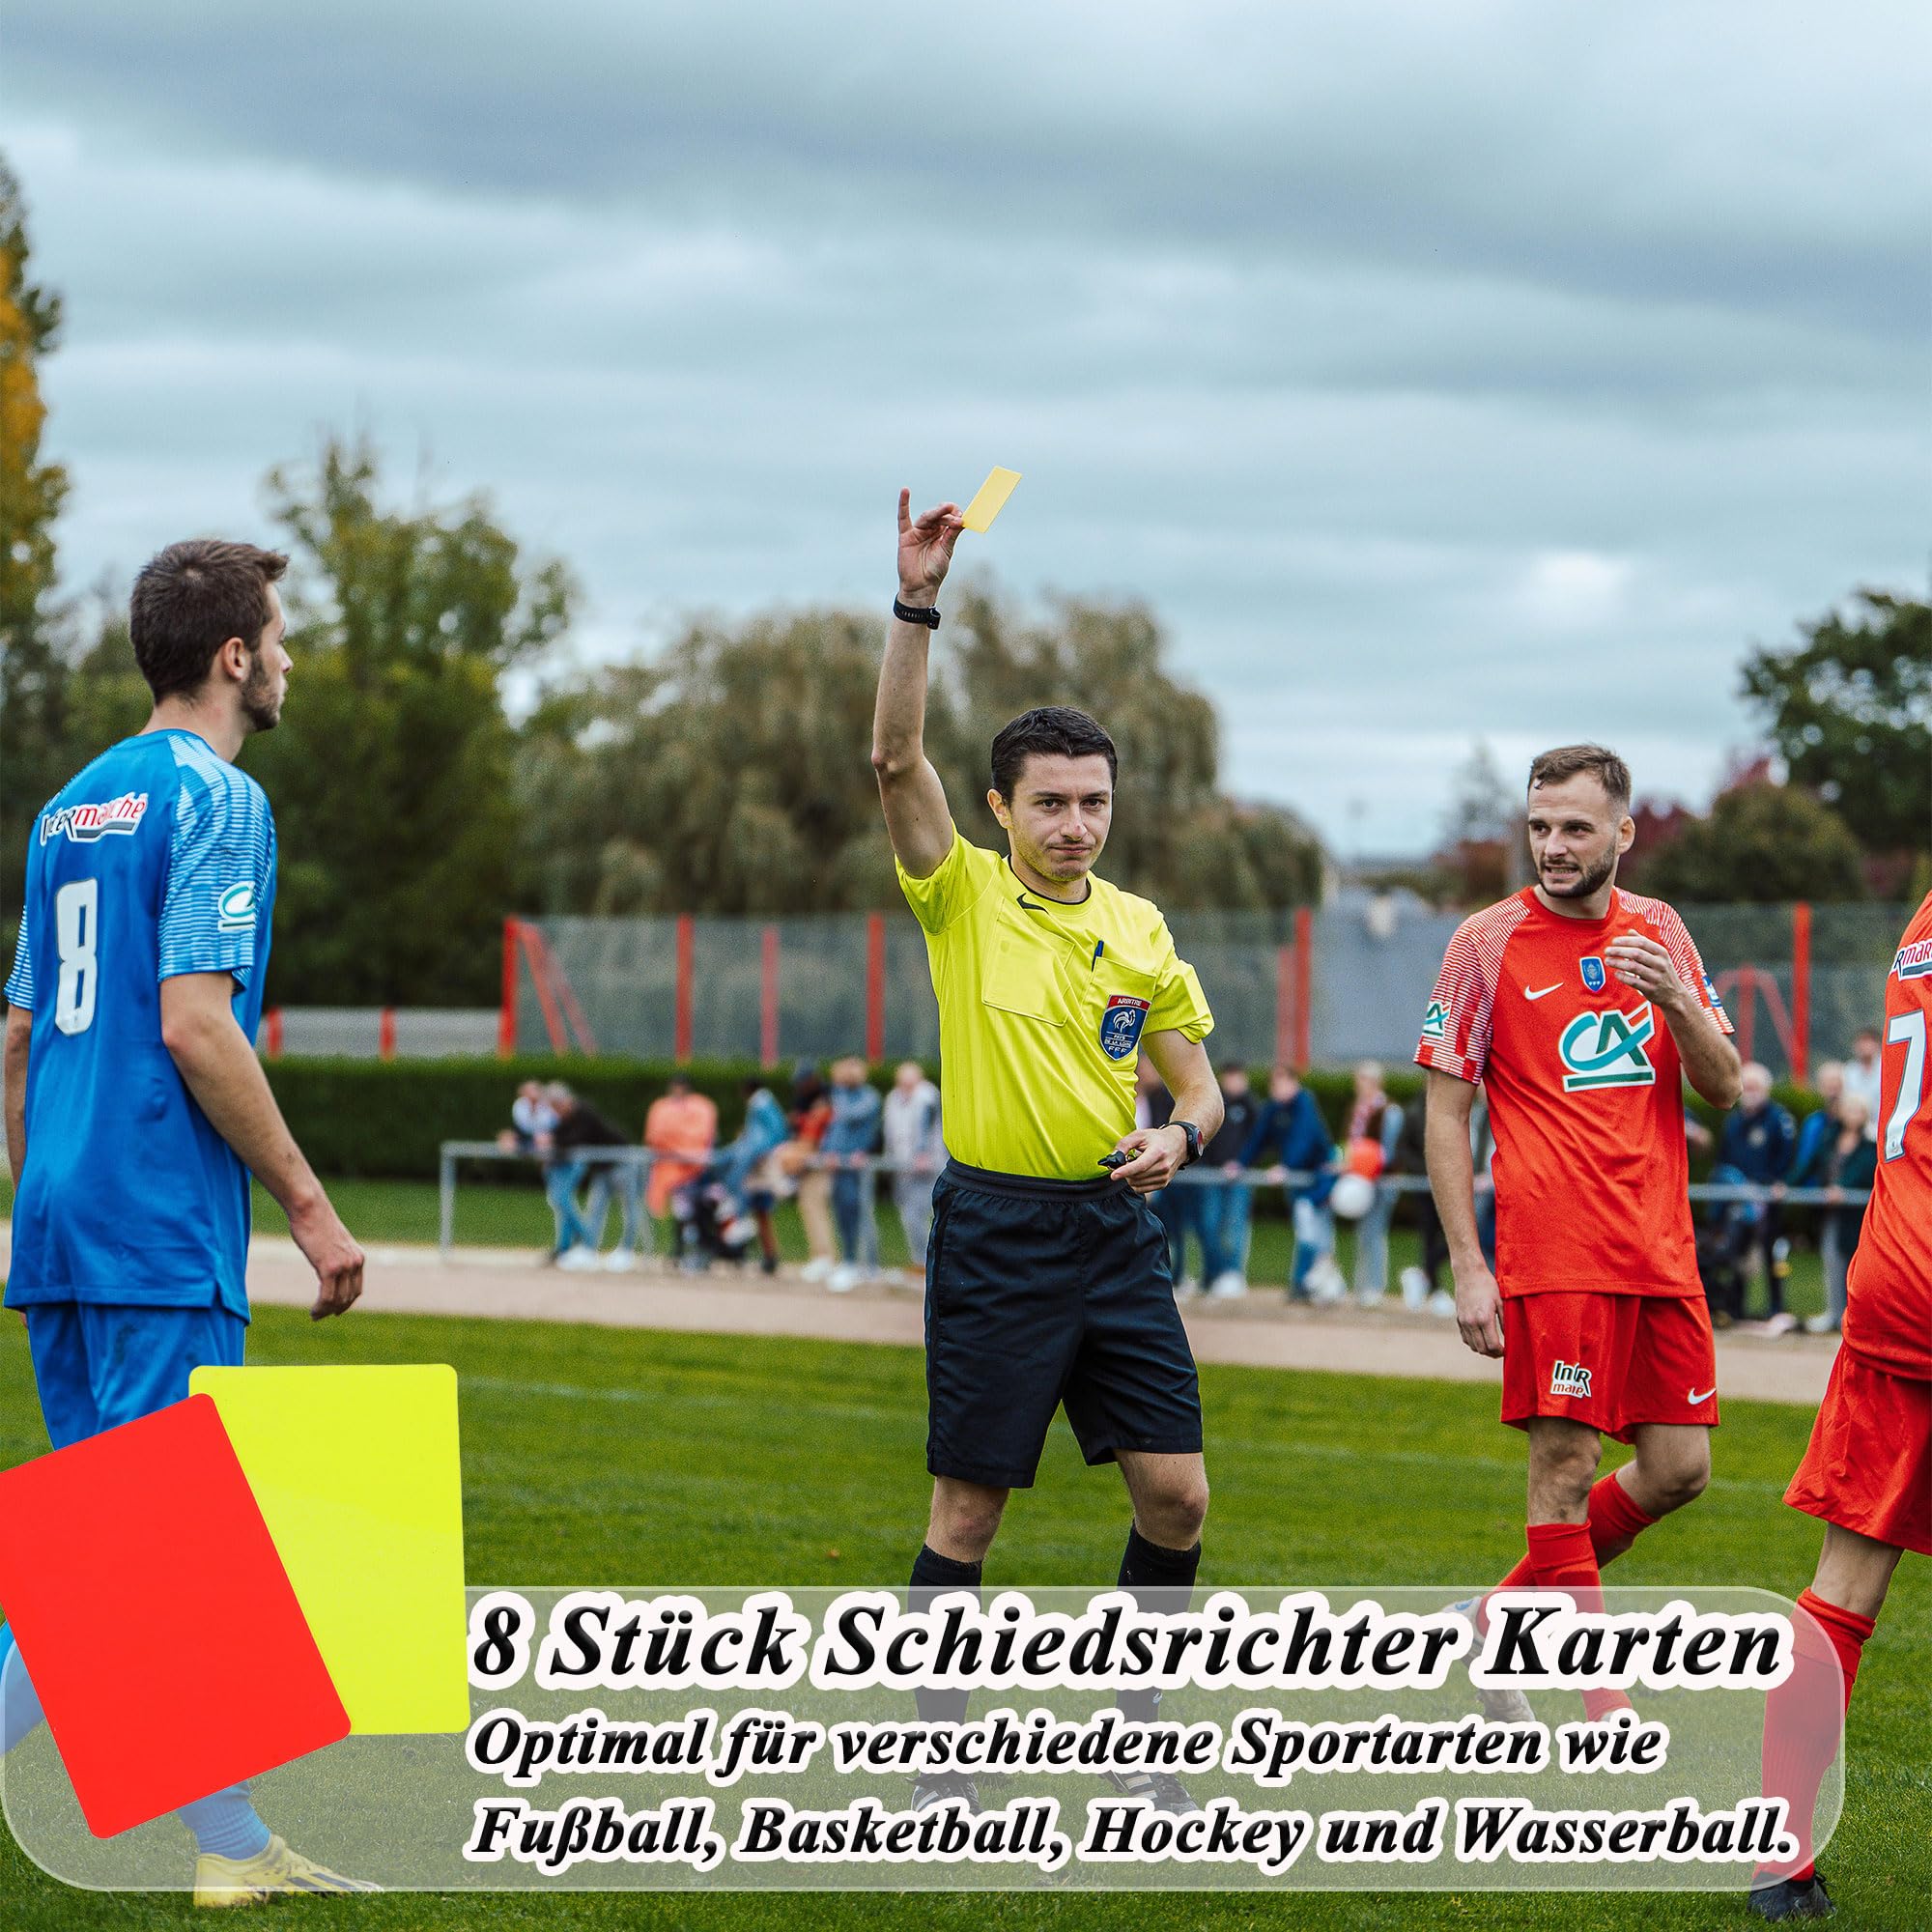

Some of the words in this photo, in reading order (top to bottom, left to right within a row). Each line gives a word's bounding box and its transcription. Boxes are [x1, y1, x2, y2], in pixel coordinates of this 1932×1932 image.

[55, 877, 98, 1037] 8
[1117, 998, 1143, 1007] ARBITRE
[1887, 1009, 1925, 1163] 7
